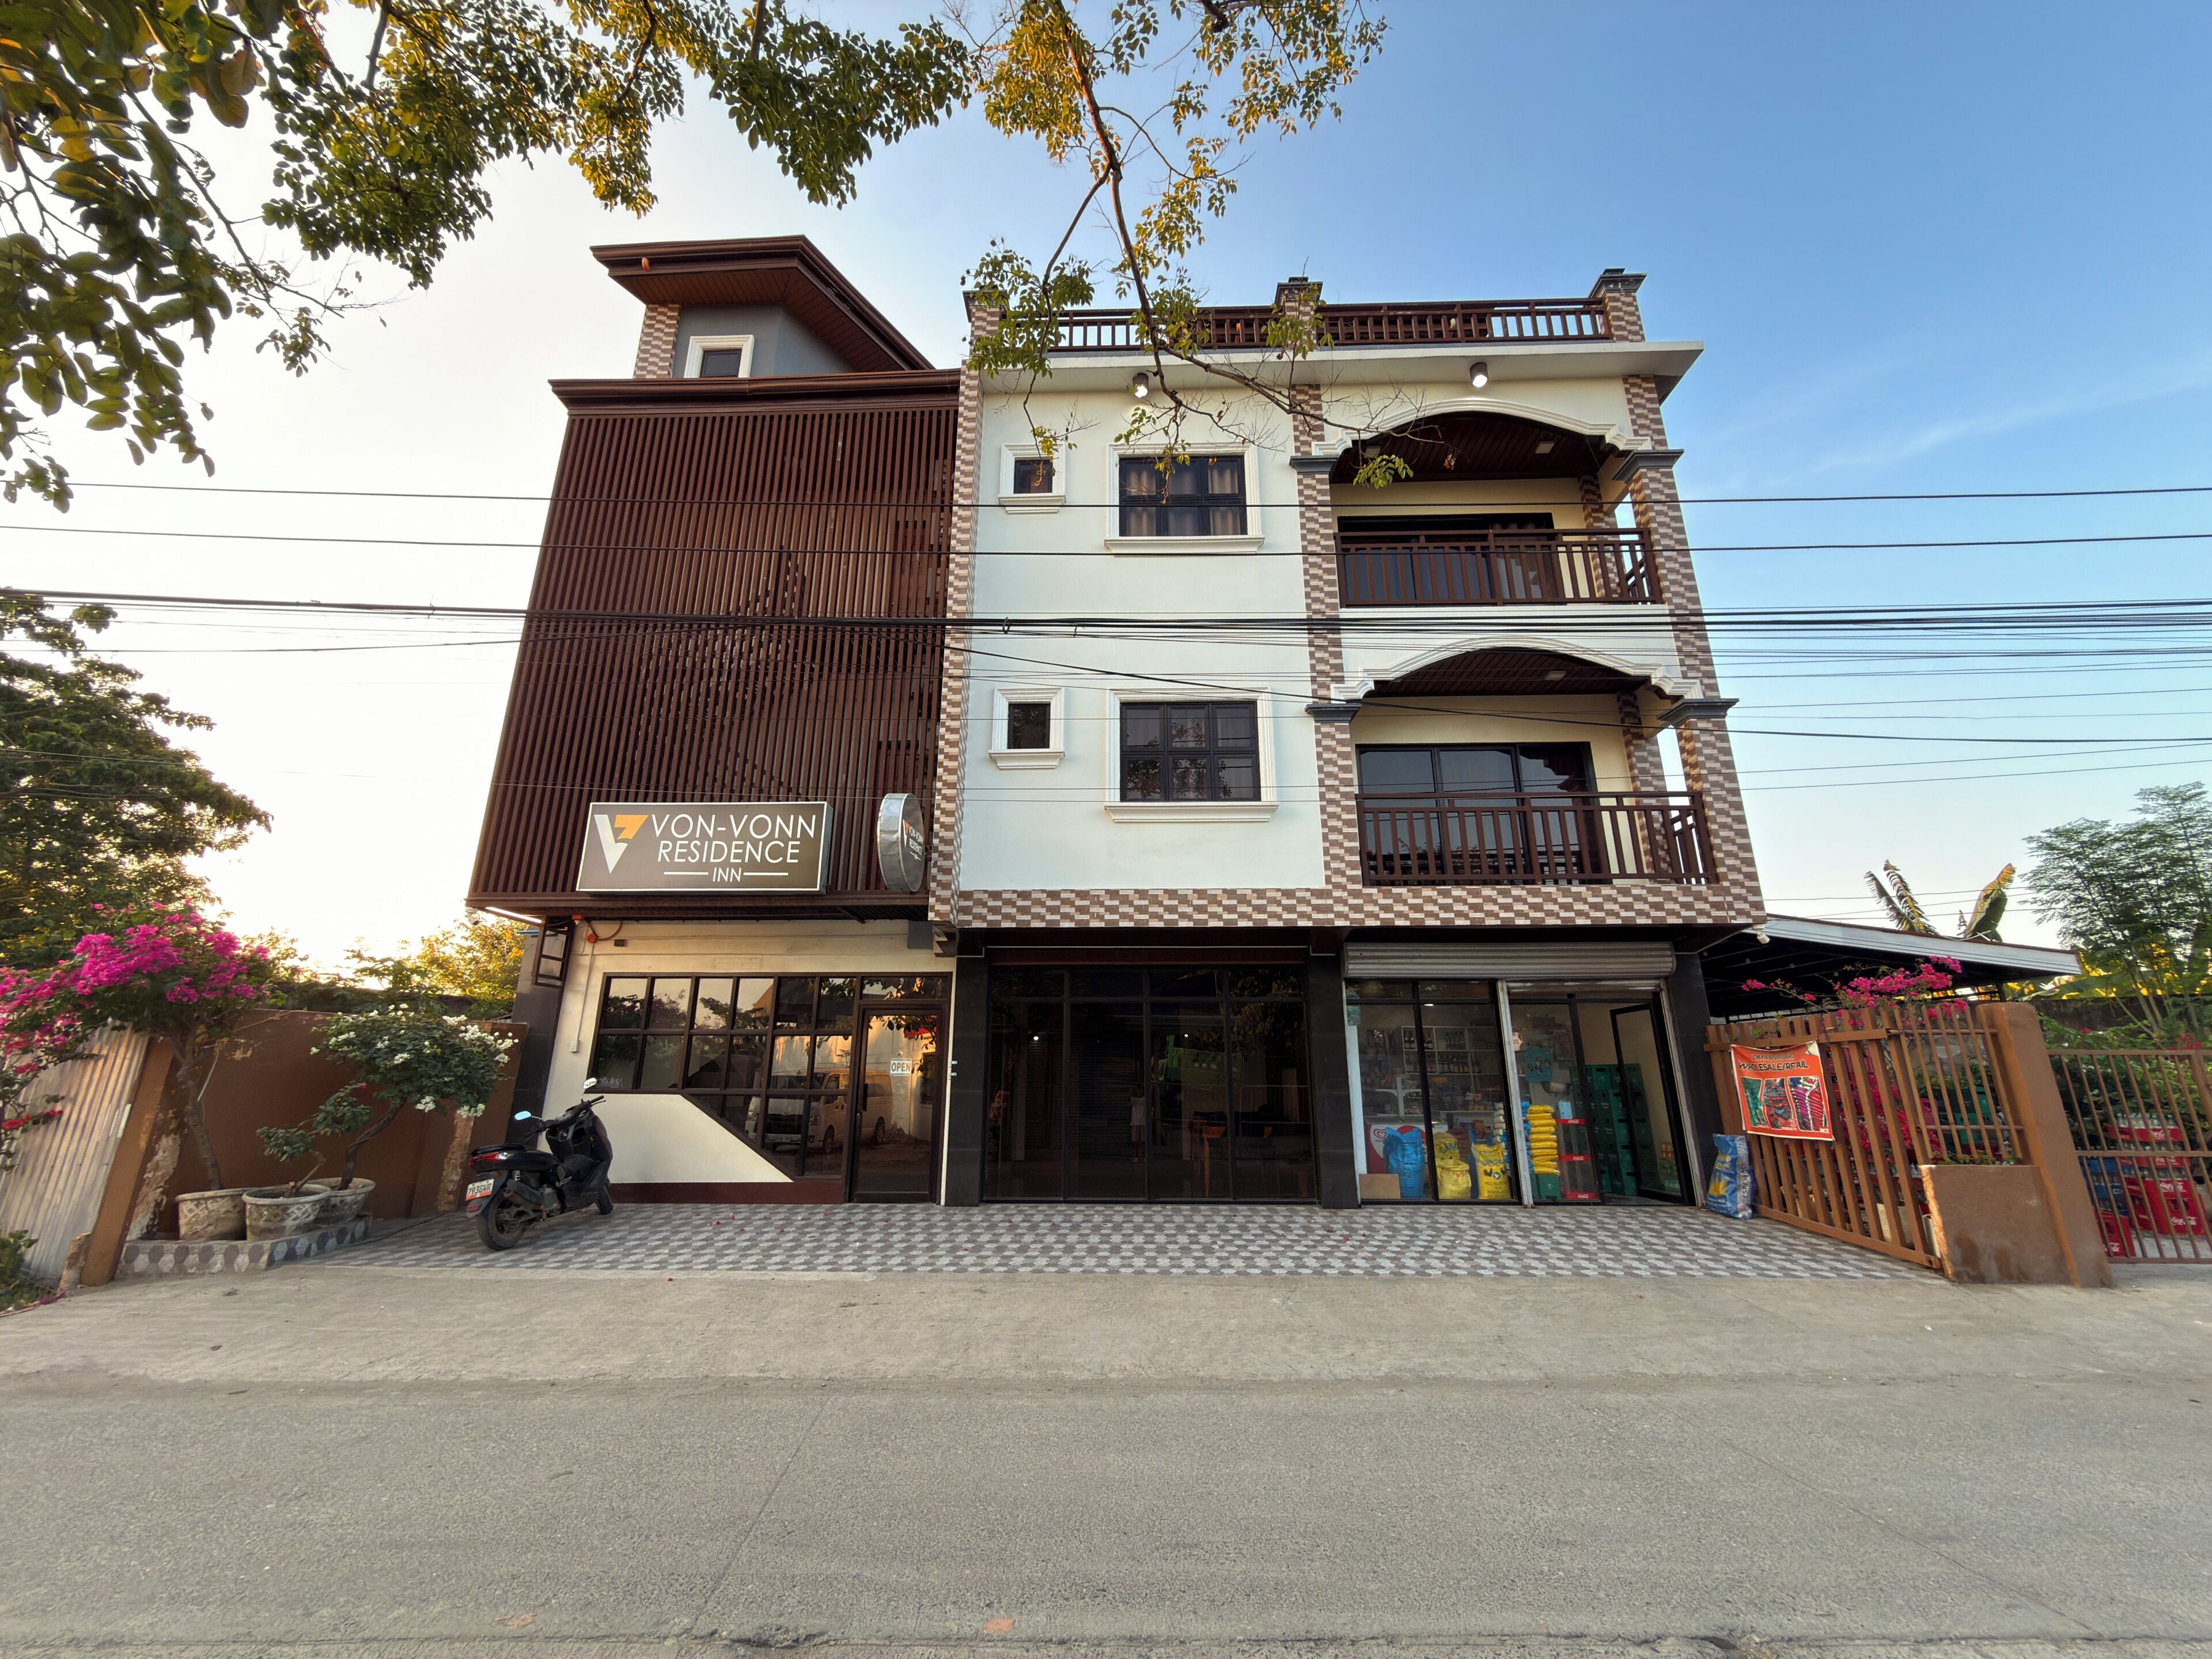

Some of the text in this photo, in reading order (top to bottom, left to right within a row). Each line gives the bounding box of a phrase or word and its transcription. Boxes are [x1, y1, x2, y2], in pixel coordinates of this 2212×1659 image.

[652, 814, 816, 839] VON-VONN
[657, 840, 801, 863] RESIDENCE
[713, 867, 742, 882] INN
[891, 1062, 911, 1071] OPEN
[468, 1183, 492, 1195] 793GWR
